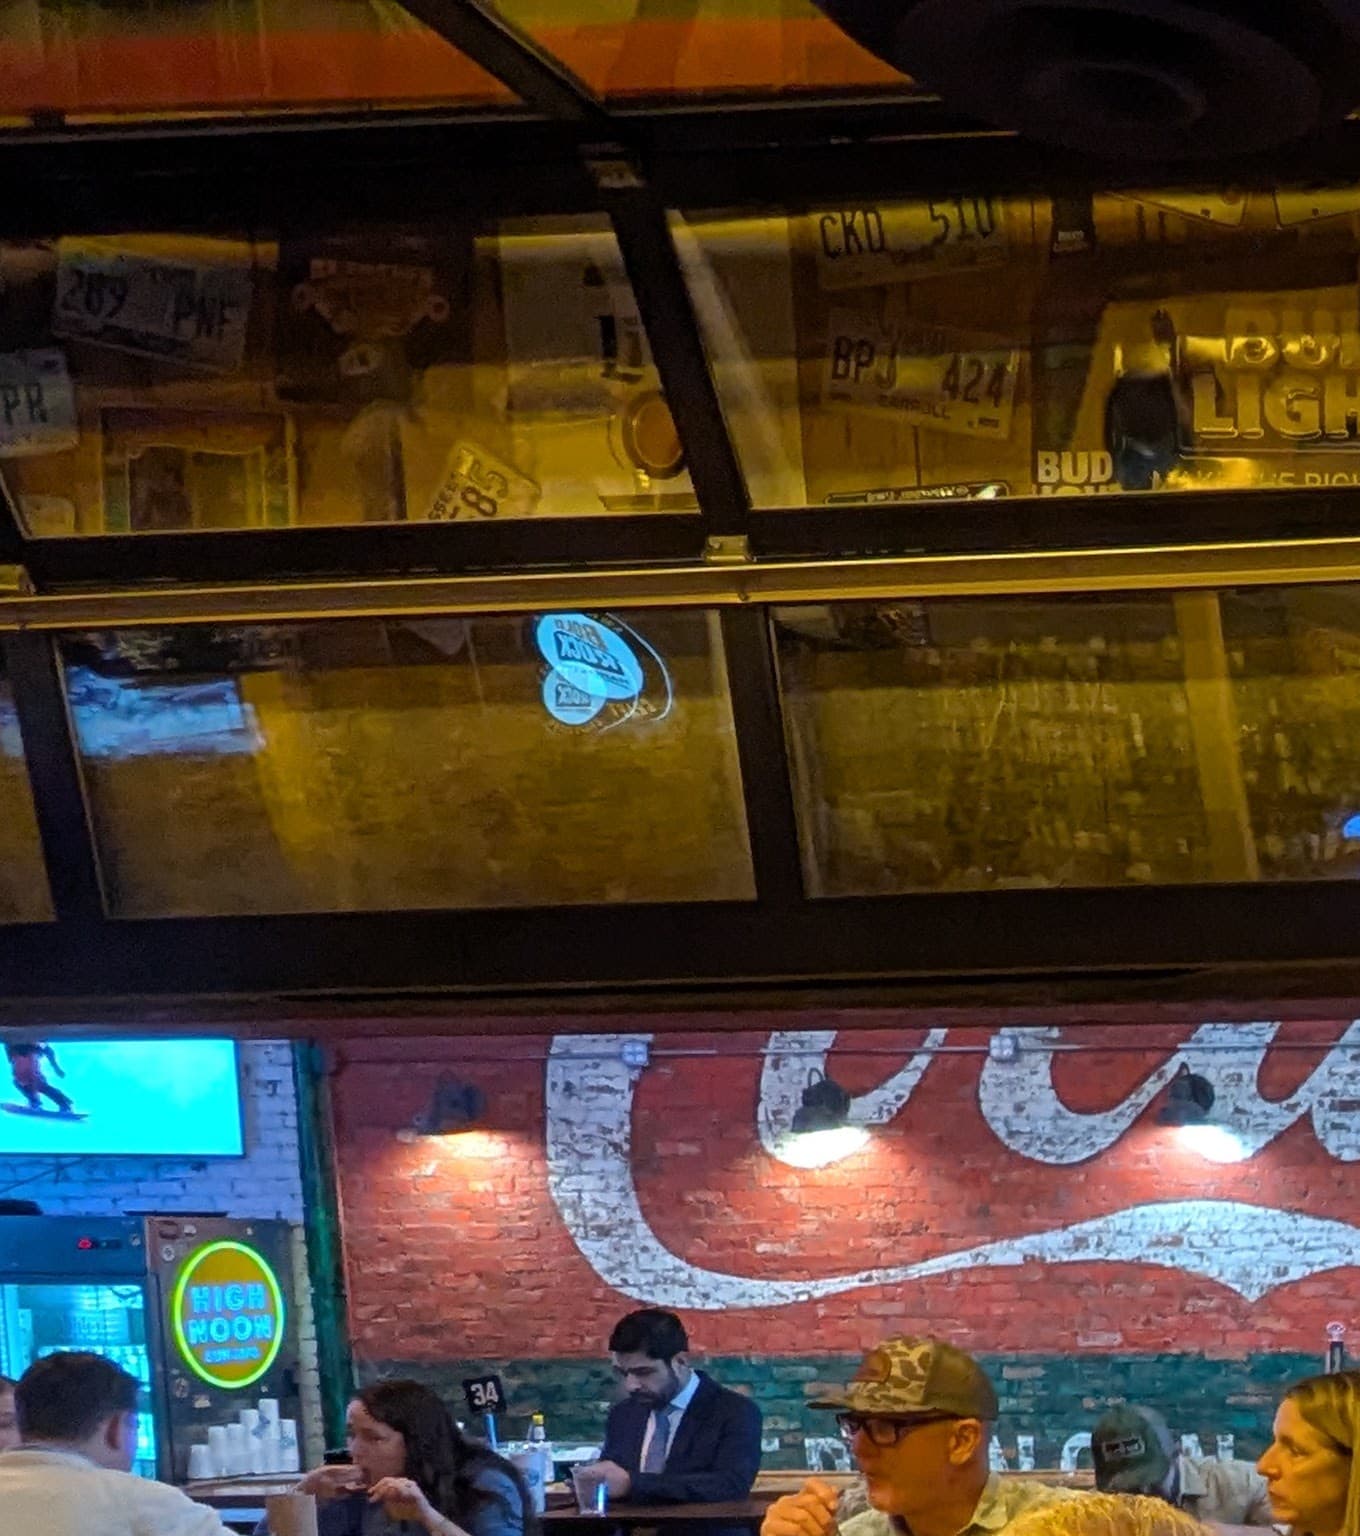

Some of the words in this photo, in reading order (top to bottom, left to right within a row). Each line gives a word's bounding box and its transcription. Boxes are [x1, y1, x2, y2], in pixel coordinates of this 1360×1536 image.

[1036, 449, 1115, 485] BUD
[191, 1283, 265, 1313] HIGH
[187, 1314, 273, 1345] NOON
[470, 1381, 499, 1406] 34
